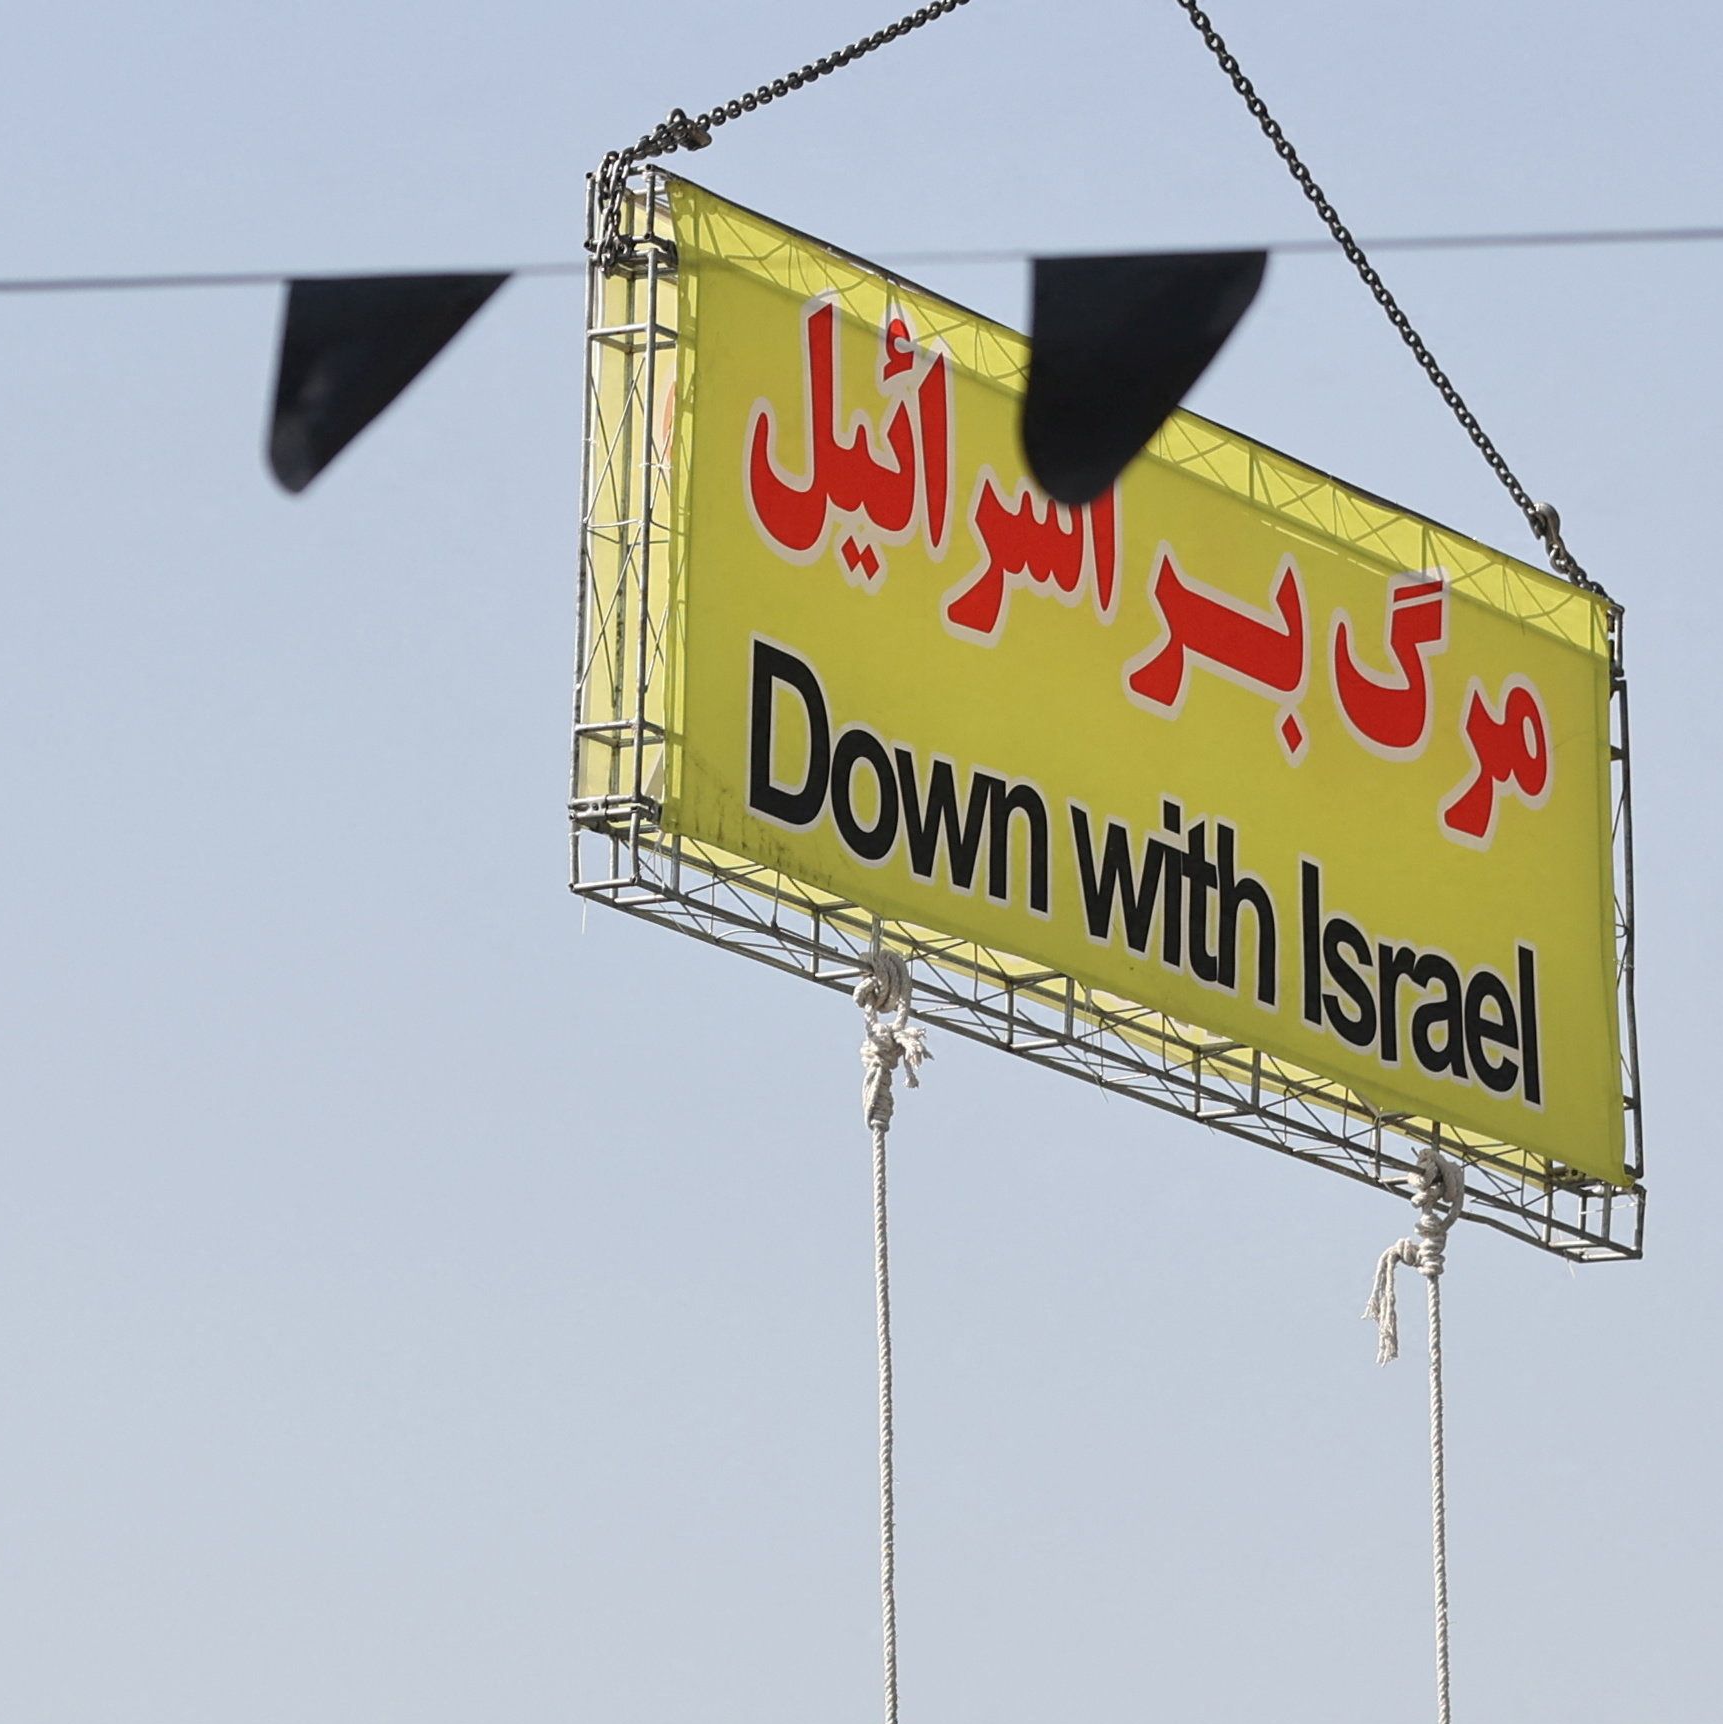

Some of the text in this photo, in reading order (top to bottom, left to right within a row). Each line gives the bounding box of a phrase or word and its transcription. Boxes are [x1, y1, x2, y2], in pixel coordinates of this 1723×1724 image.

[1129, 557, 1304, 754] بر
[1334, 580, 1548, 838] مرگ
[749, 639, 1541, 1105] Down with Israel
